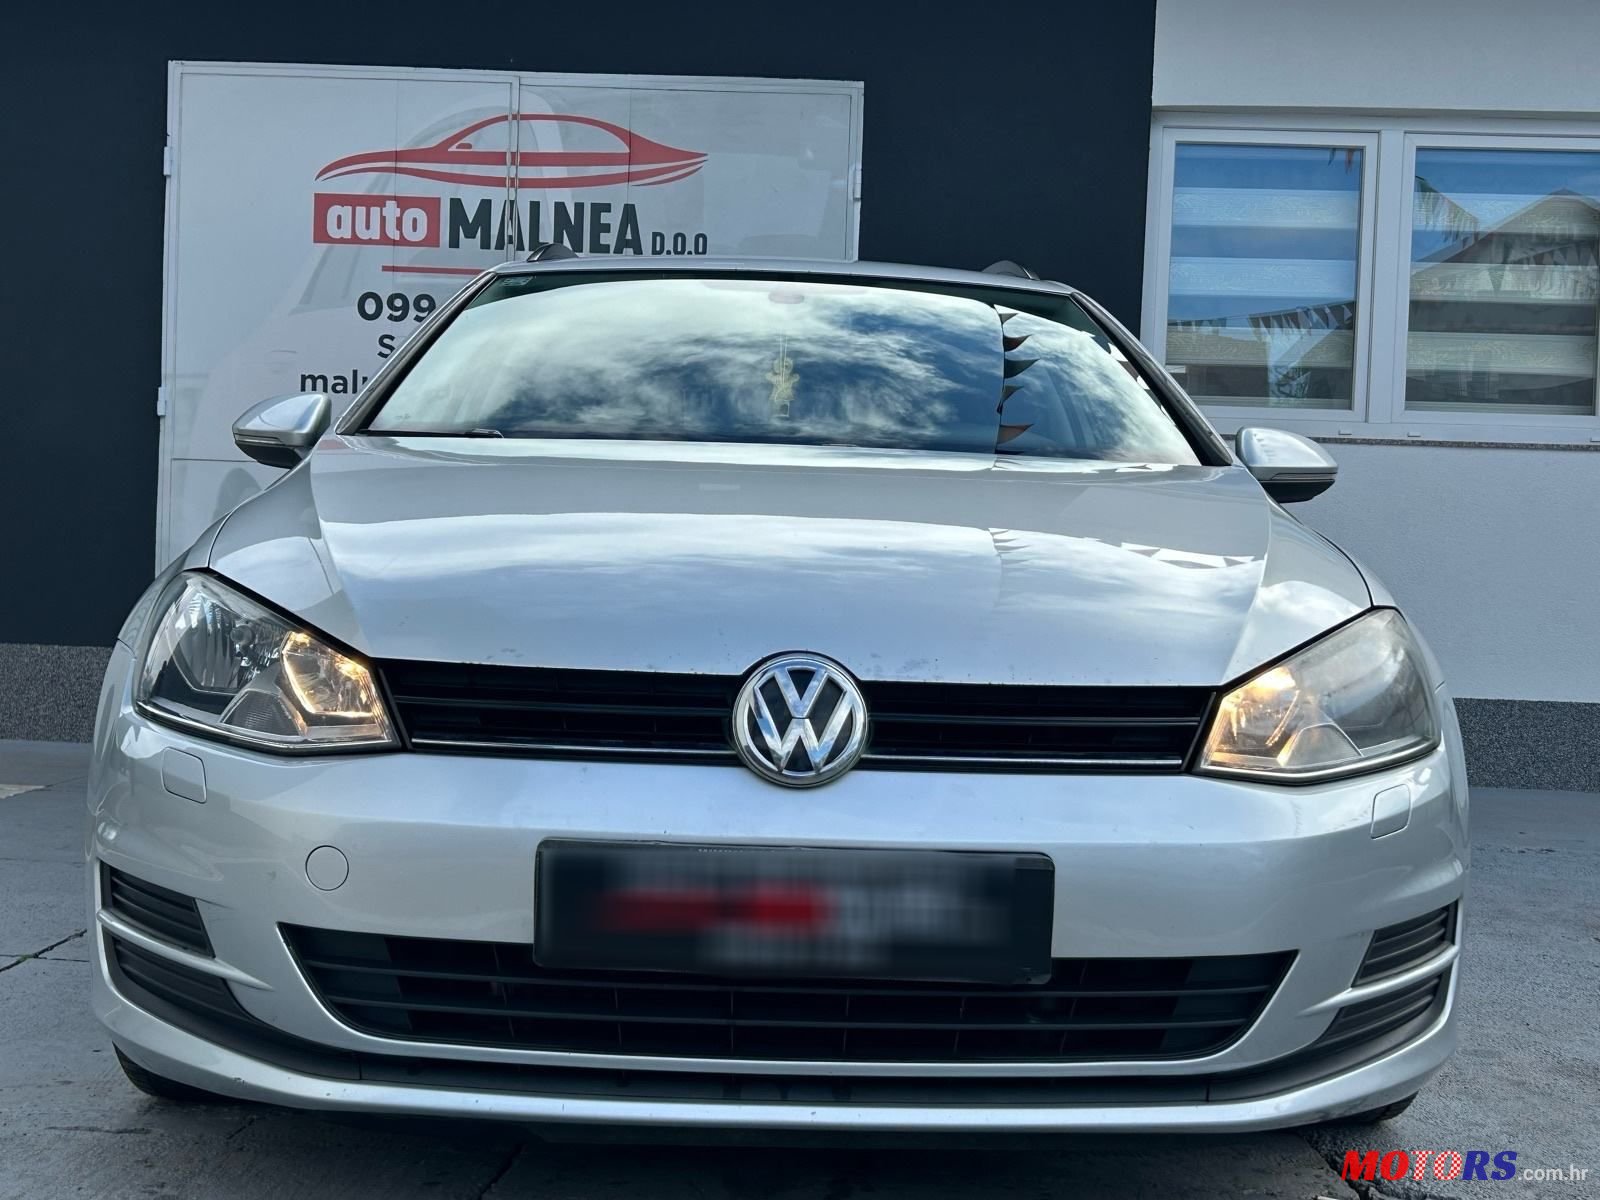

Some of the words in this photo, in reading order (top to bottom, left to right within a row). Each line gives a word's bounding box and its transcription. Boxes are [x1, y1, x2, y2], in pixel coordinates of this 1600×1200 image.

[326, 200, 428, 242] auto
[448, 197, 644, 255] MALNEA
[357, 291, 437, 323] 099
